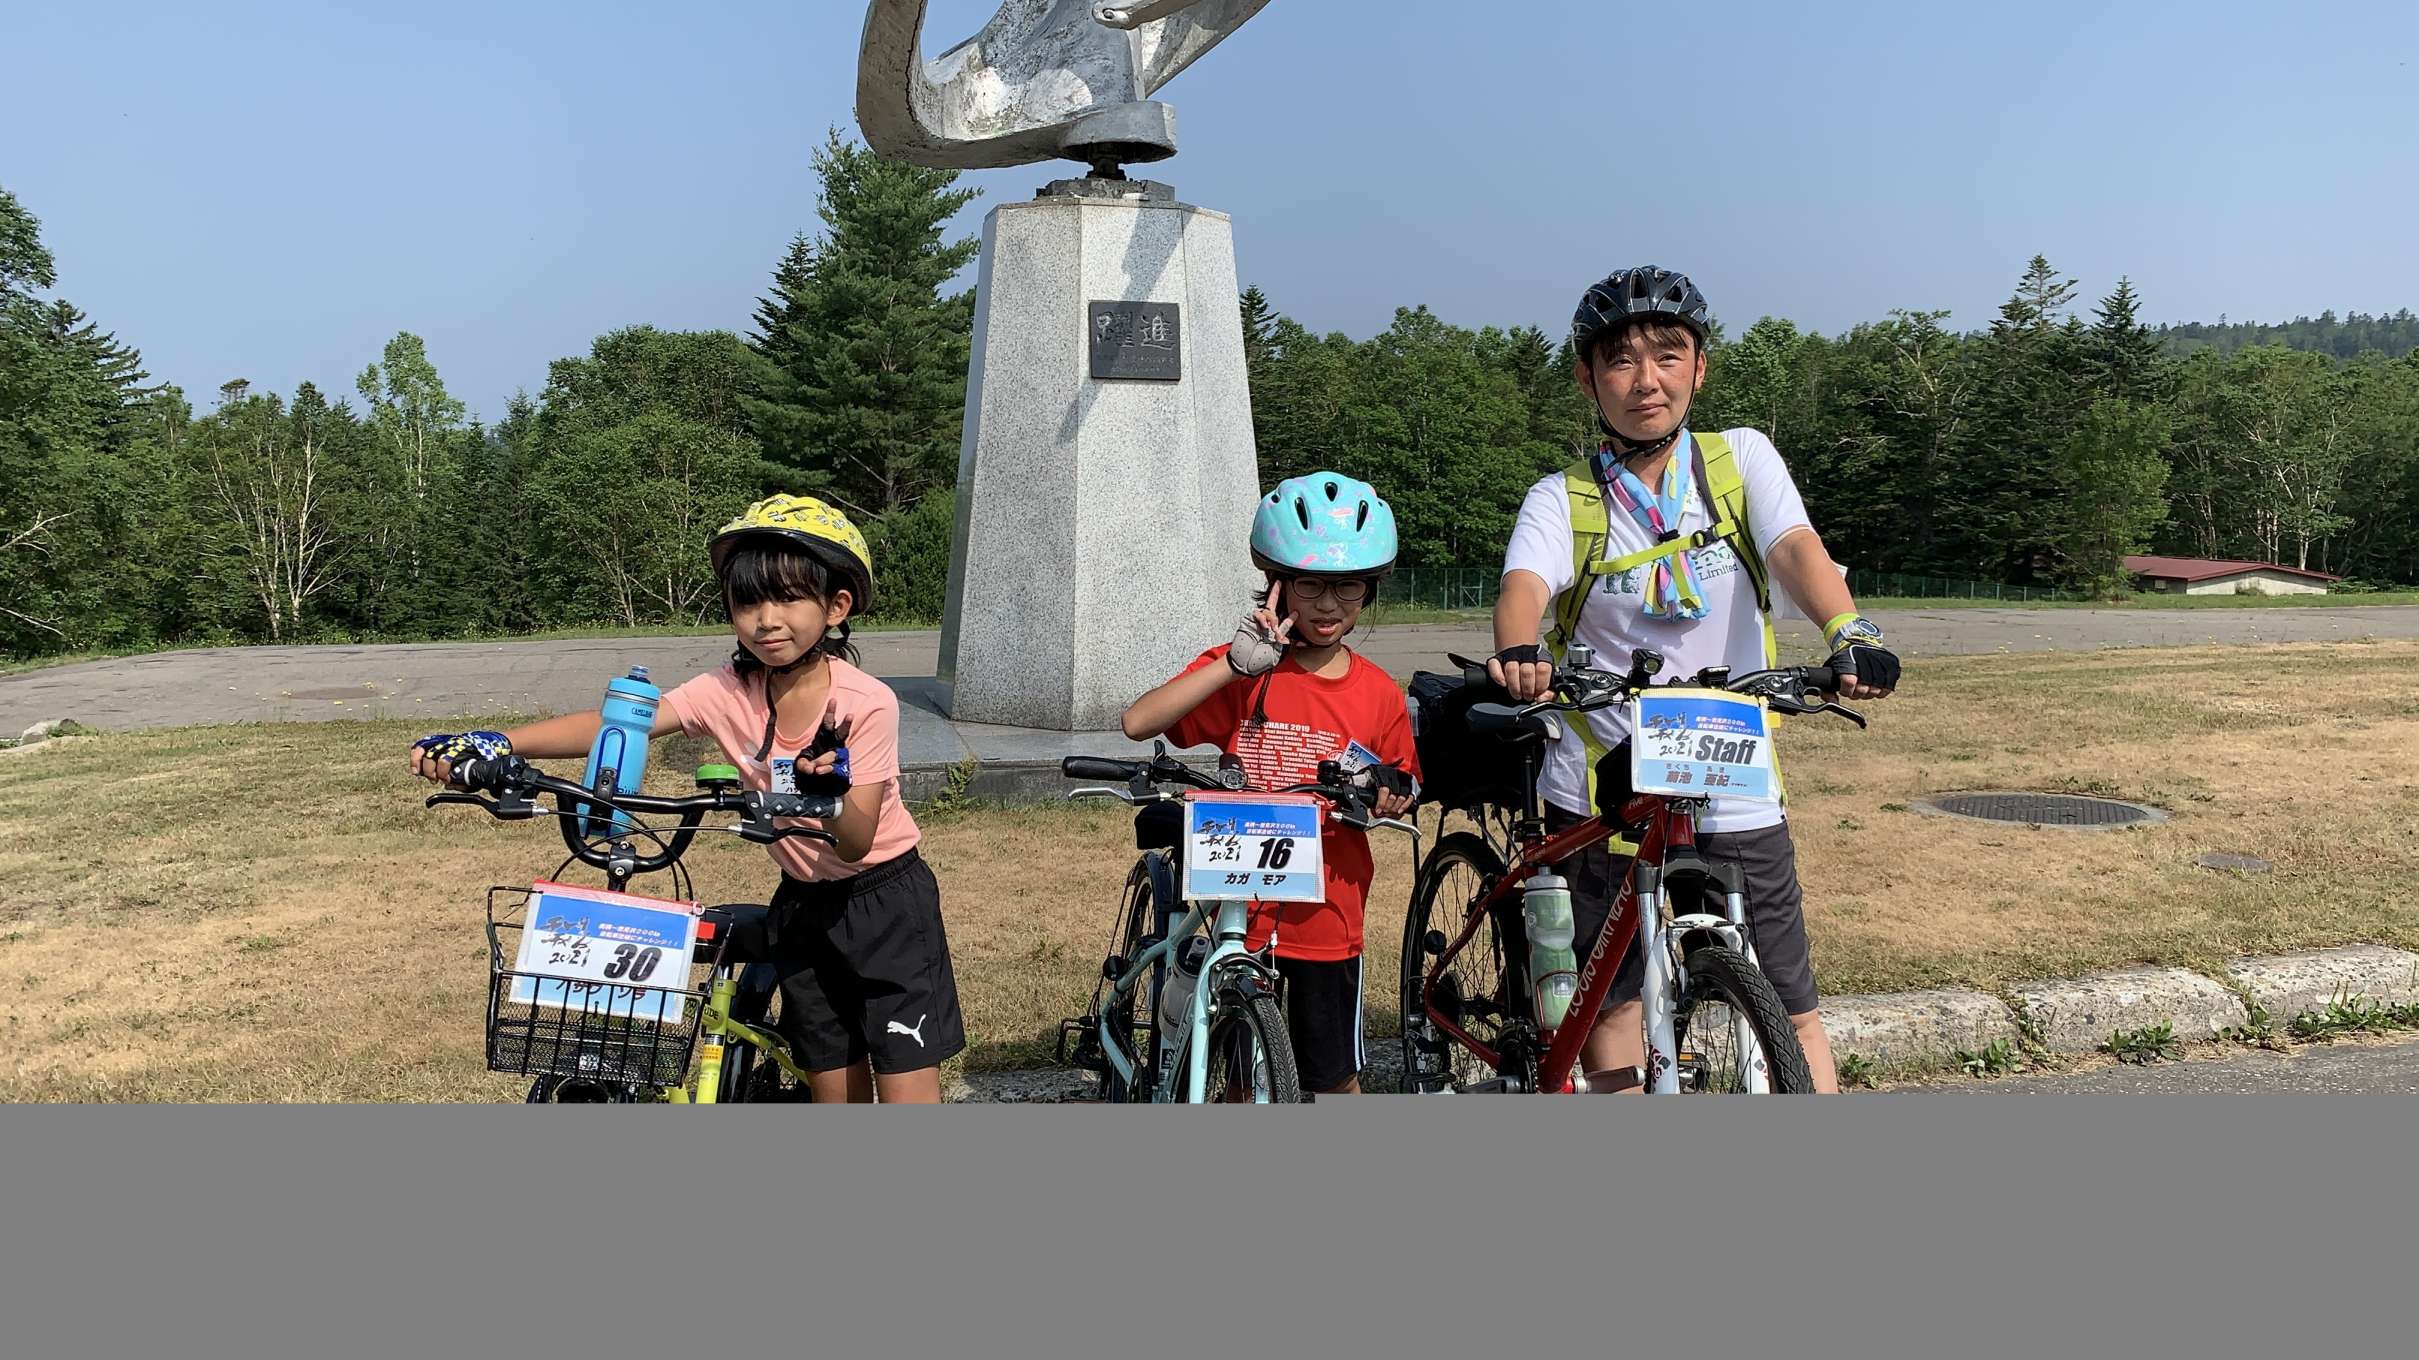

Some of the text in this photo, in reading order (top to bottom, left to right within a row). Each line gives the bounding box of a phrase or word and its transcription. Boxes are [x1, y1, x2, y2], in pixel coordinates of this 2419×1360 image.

[1698, 563, 1738, 581] Limited
[1659, 741, 1692, 756] 2021
[1695, 734, 1757, 765] Staff
[1209, 845, 1242, 862] 2021
[1257, 838, 1295, 870] 16
[1224, 873, 1287, 886] カガ モア
[548, 948, 591, 967] 2021
[603, 943, 662, 982] 30
